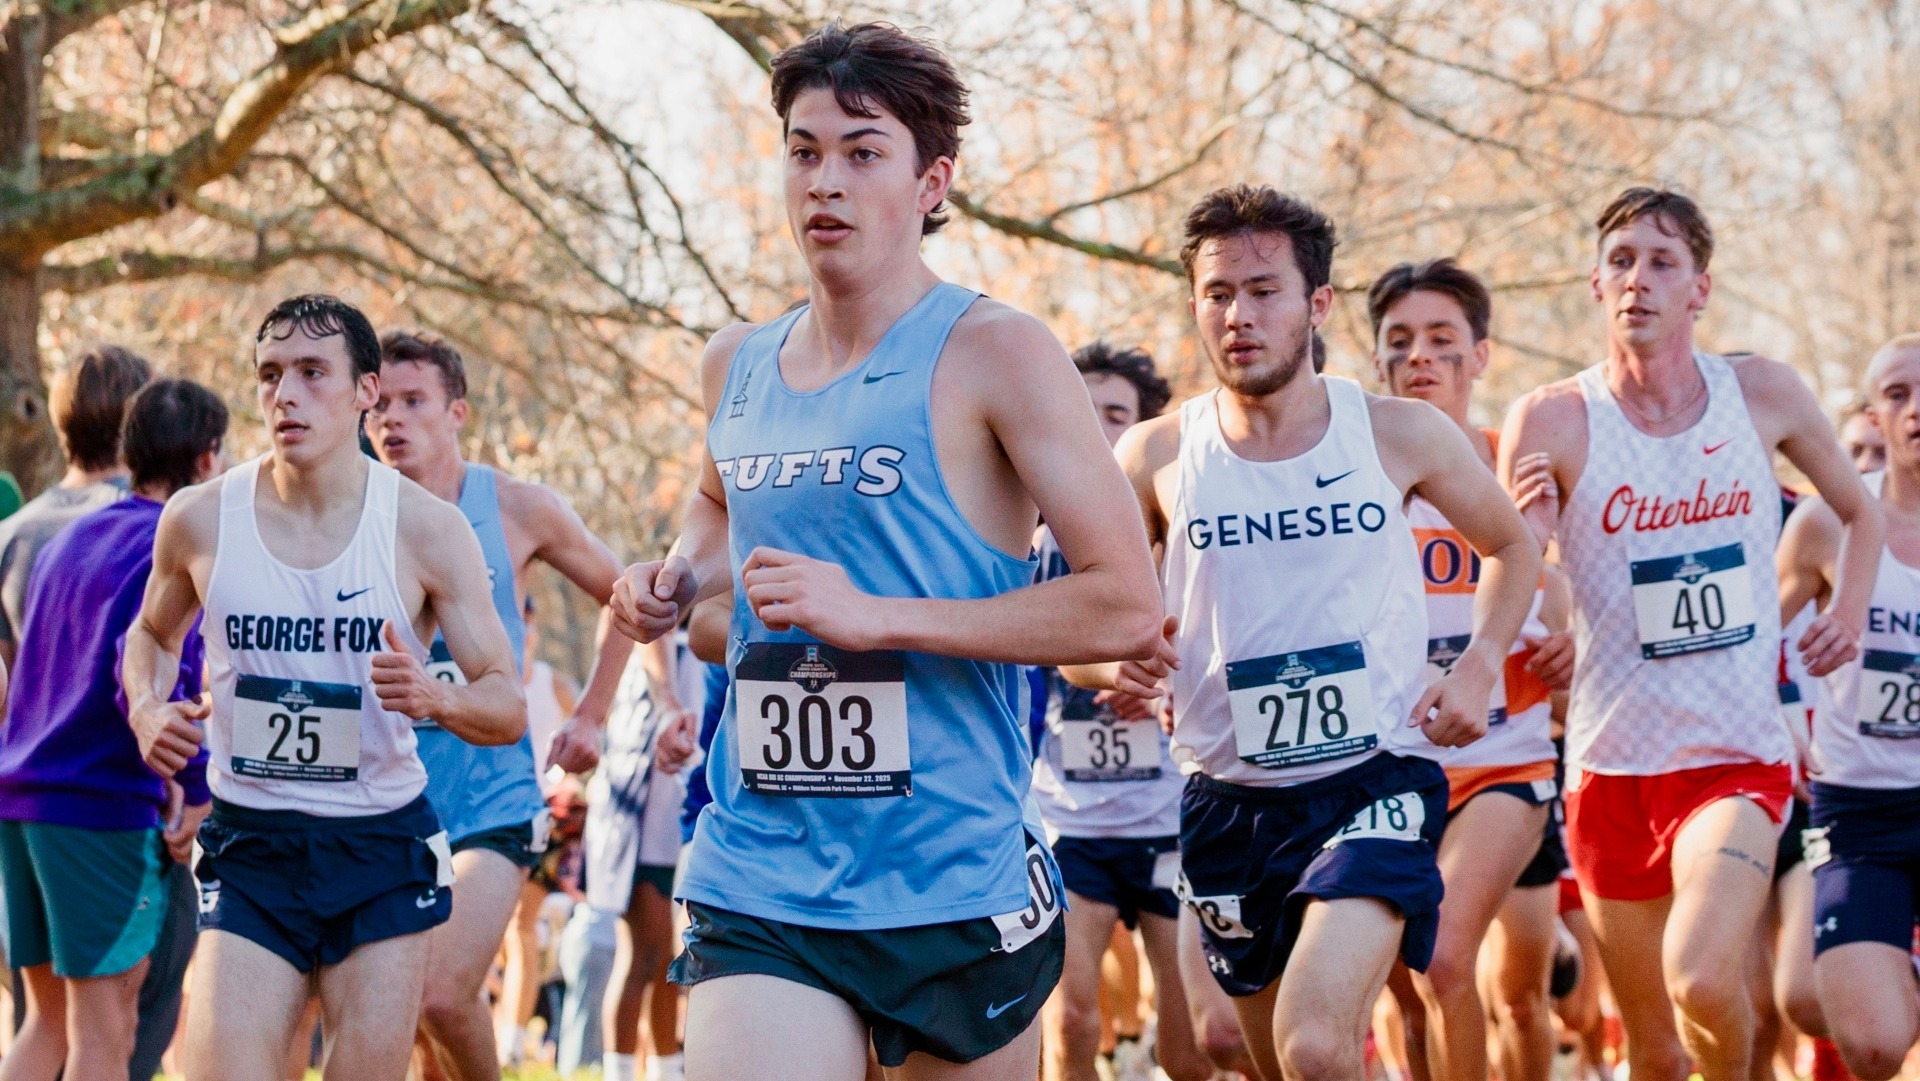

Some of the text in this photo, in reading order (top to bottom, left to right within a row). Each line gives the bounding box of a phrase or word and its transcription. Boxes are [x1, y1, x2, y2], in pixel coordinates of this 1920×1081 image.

[1188, 502, 1386, 550] GENESEO
[1602, 478, 1753, 535] Otterbein
[226, 614, 385, 653] GEORGE FOX
[1672, 583, 1726, 635] 40
[267, 713, 321, 764] 25
[760, 694, 876, 771] 303
[1258, 684, 1348, 751] 278
[1088, 728, 1131, 769] 35
